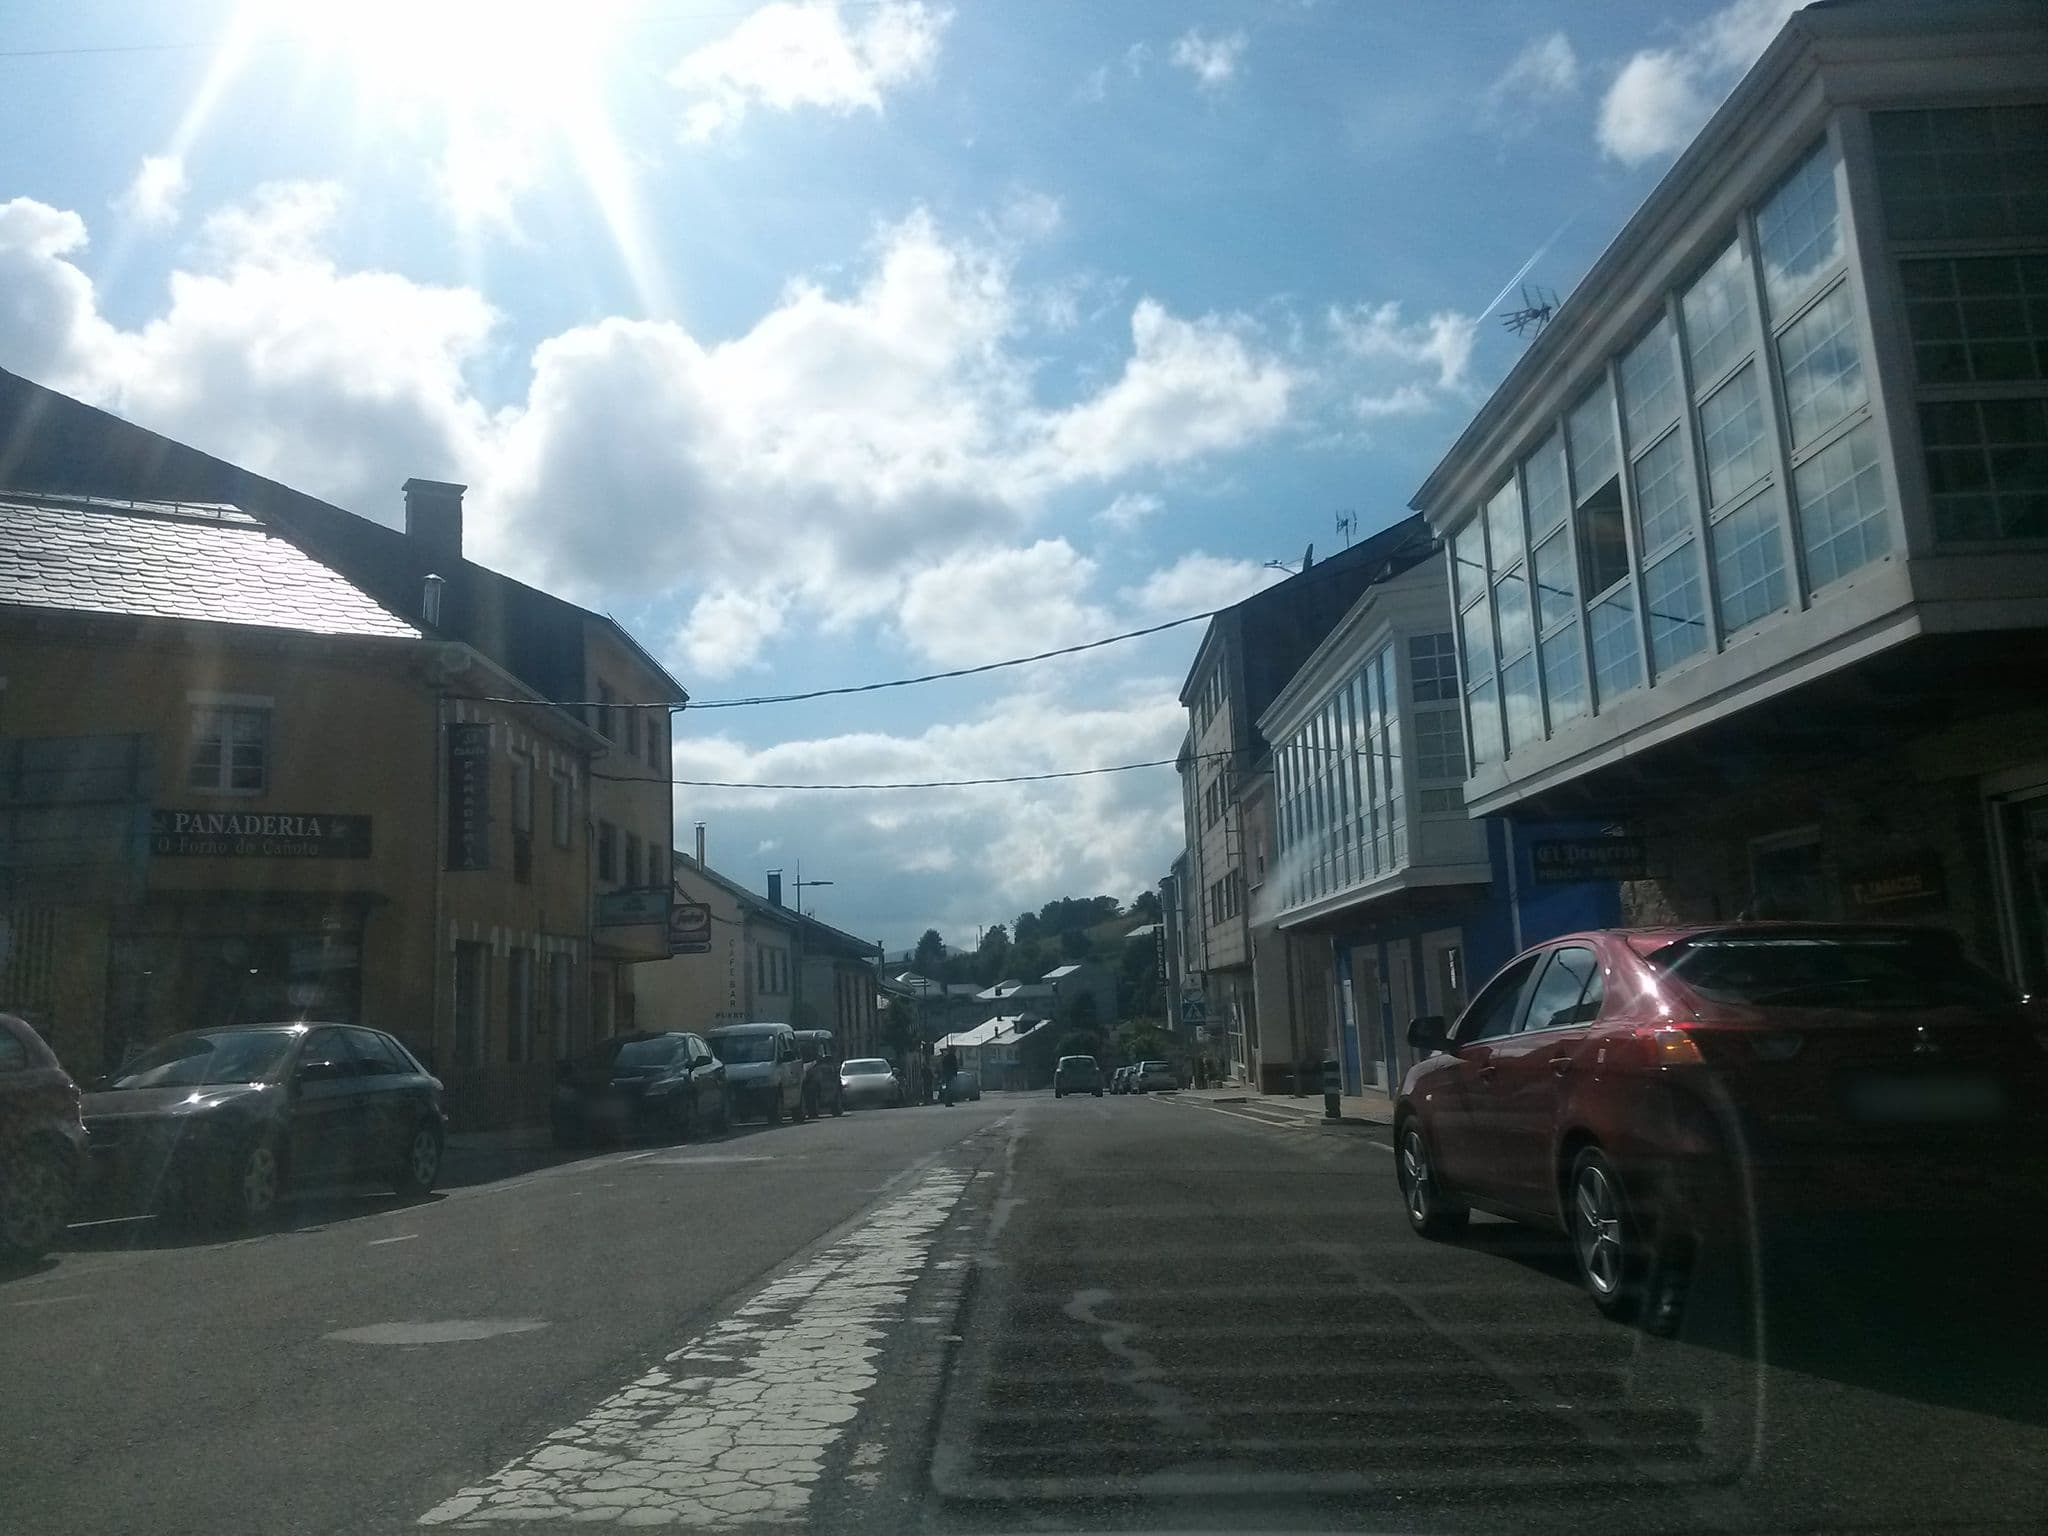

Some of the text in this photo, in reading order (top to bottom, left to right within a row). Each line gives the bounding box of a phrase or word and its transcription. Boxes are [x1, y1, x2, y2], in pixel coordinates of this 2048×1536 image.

[174, 812, 321, 837] PANADERIA
[158, 838, 170, 853] O
[178, 837, 228, 854] Forno
